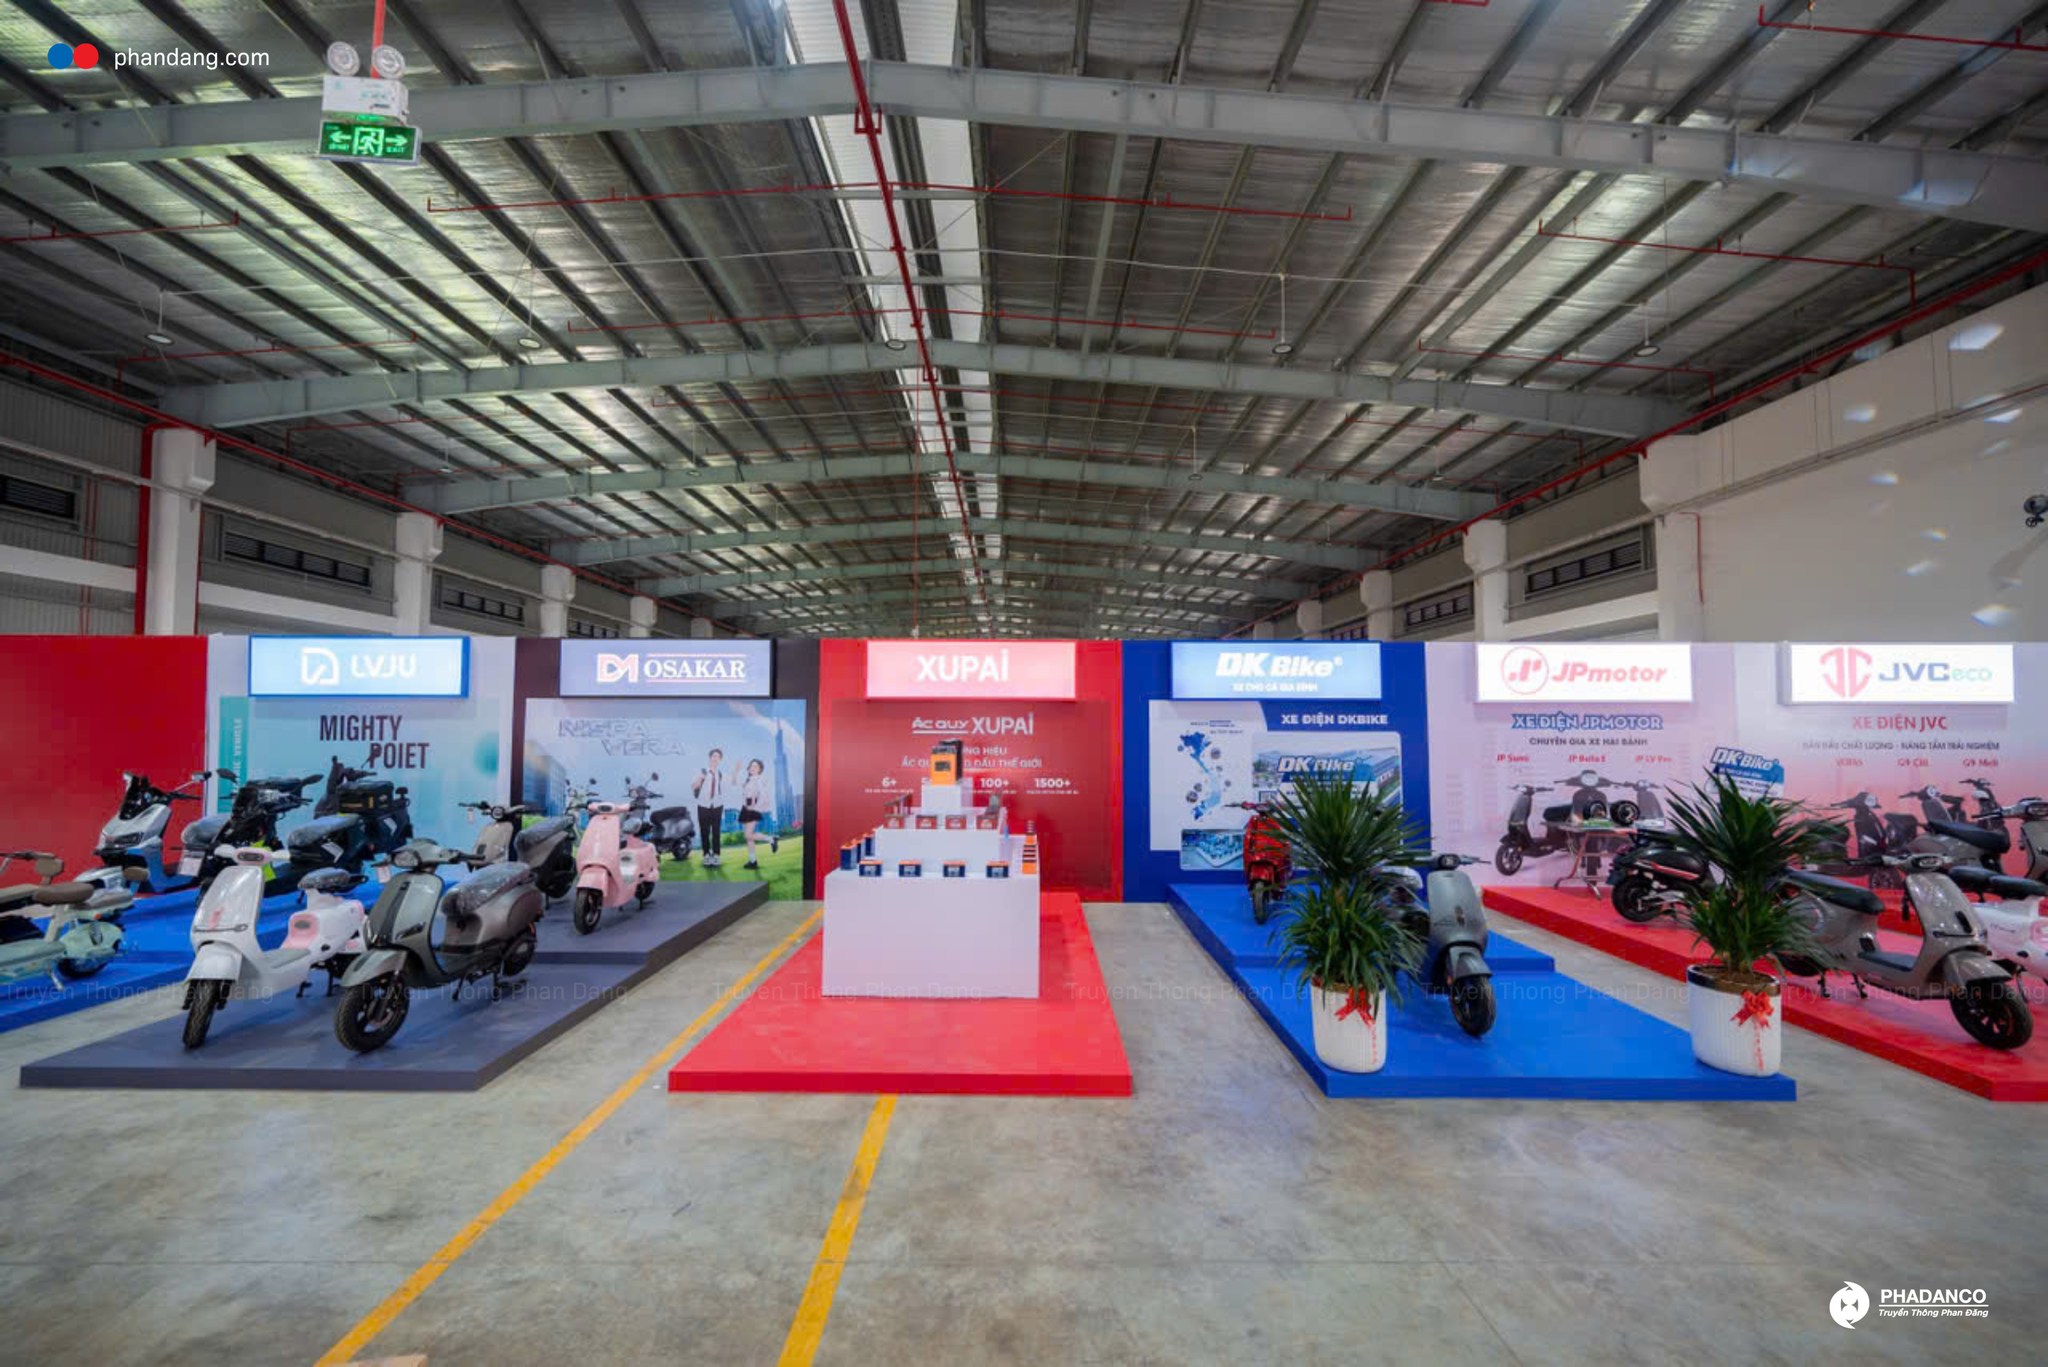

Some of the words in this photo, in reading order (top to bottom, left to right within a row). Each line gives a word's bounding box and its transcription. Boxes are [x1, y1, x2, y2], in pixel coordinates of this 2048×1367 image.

[351, 654, 416, 678] LVJU
[643, 659, 746, 678] OSAKAR
[1216, 652, 1270, 677] DK
[1552, 661, 1667, 682] JPmotor
[319, 715, 402, 741] MIGHTY
[1281, 714, 1299, 725] XE
[1302, 712, 1334, 727] ĐIỆN
[1338, 715, 1388, 725] DKBIKE
[1512, 714, 1537, 729] XE
[1581, 715, 1663, 730] JPMOTOR
[1853, 717, 1873, 729] XE
[1876, 714, 1917, 731] ĐIỆN
[1919, 717, 1948, 732] JVC
[1588, 738, 1601, 746] XE
[369, 742, 429, 768] POIET
[1278, 756, 1315, 772] DK
[881, 777, 897, 788] 6+
[980, 778, 1010, 788] 100+
[1034, 778, 1071, 788] 1500+
